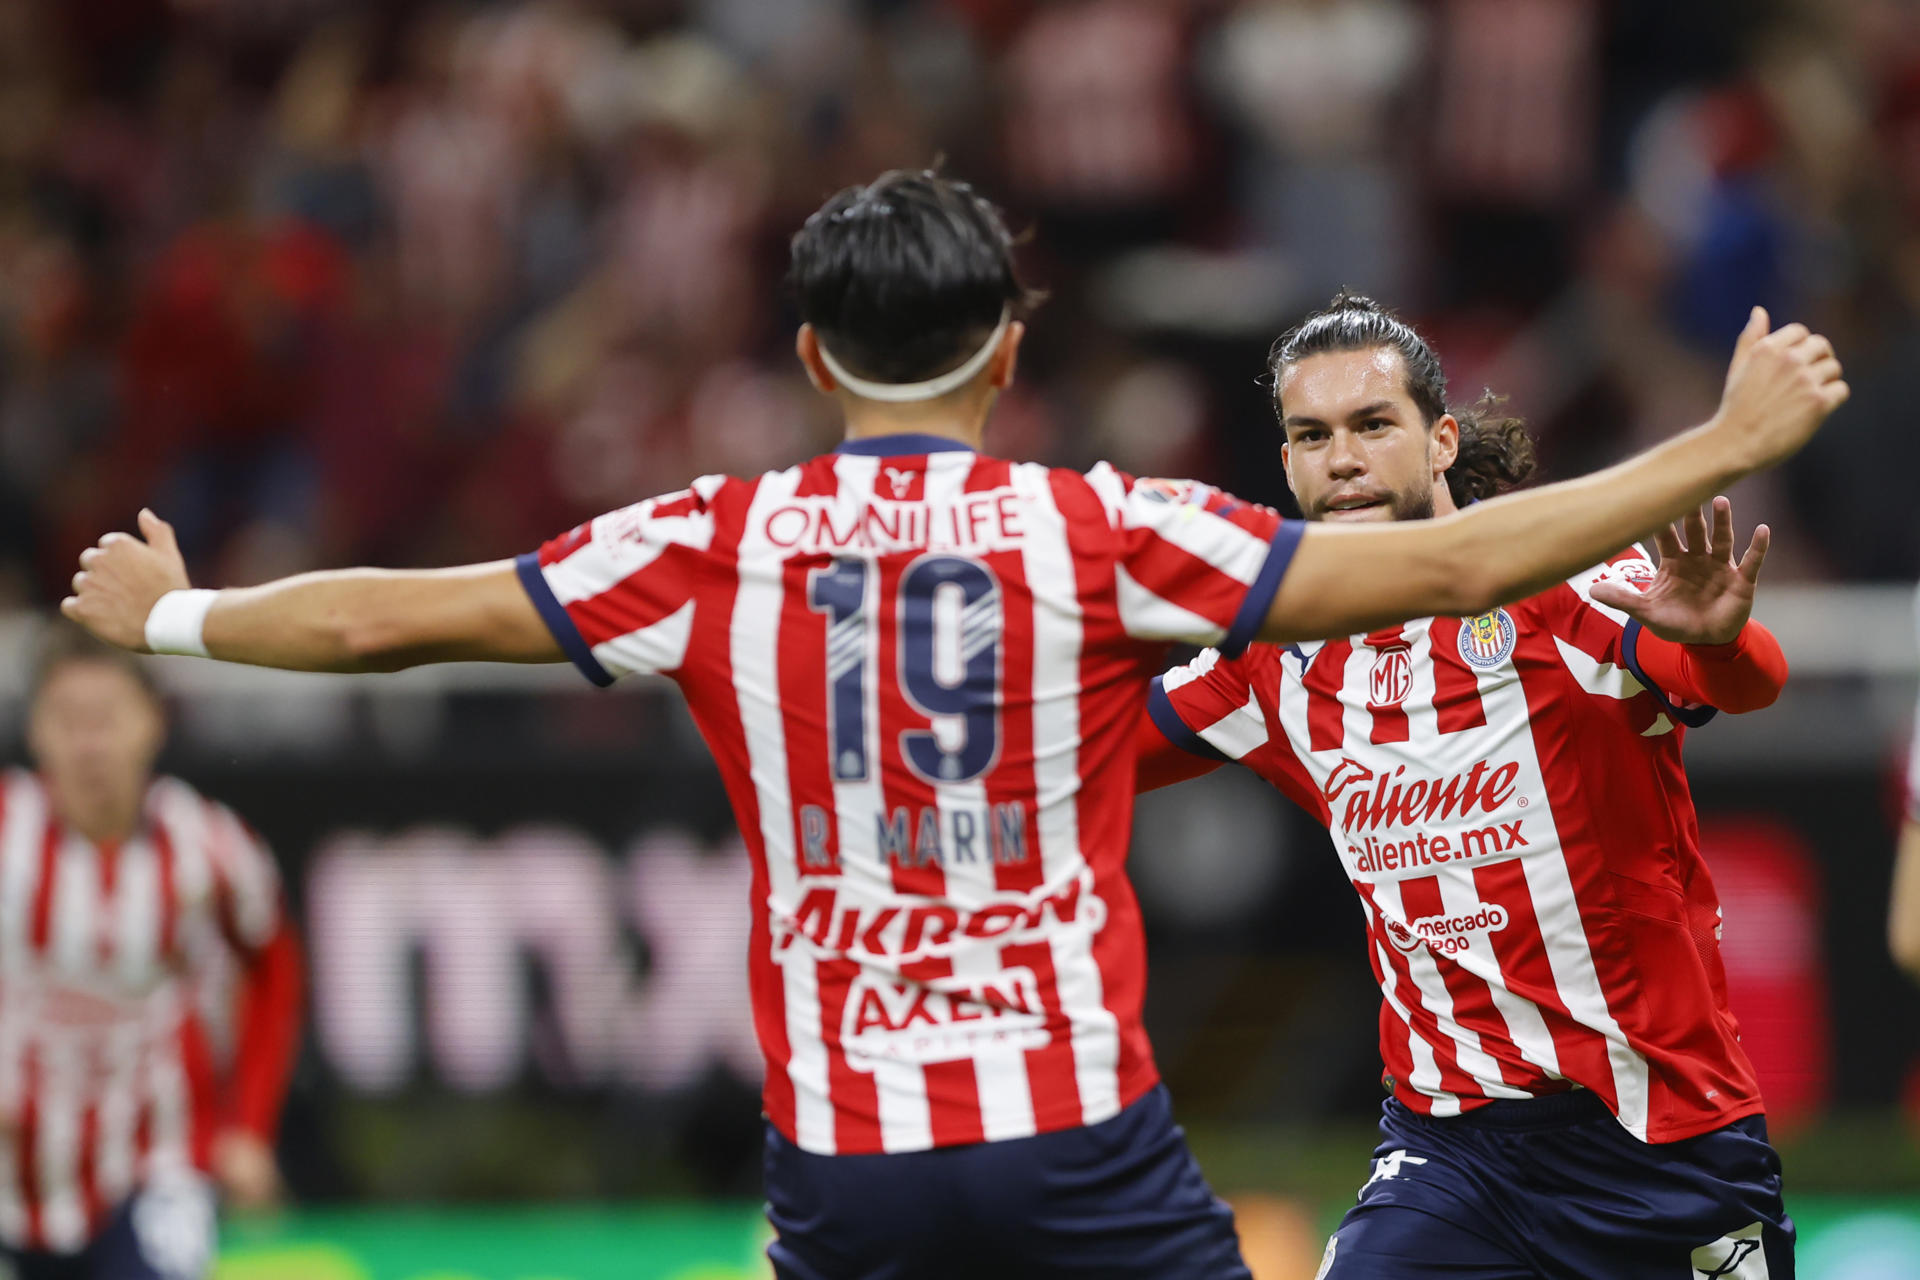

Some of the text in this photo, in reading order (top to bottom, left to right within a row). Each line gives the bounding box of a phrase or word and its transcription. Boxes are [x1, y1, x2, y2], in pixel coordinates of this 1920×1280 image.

[766, 495, 1025, 548] OMNILIFE
[807, 554, 1004, 784] 19
[1374, 653, 1410, 703] MG
[780, 877, 1080, 956] AKRON
[1417, 908, 1502, 937] mercado
[855, 980, 1031, 1035] AXEN
